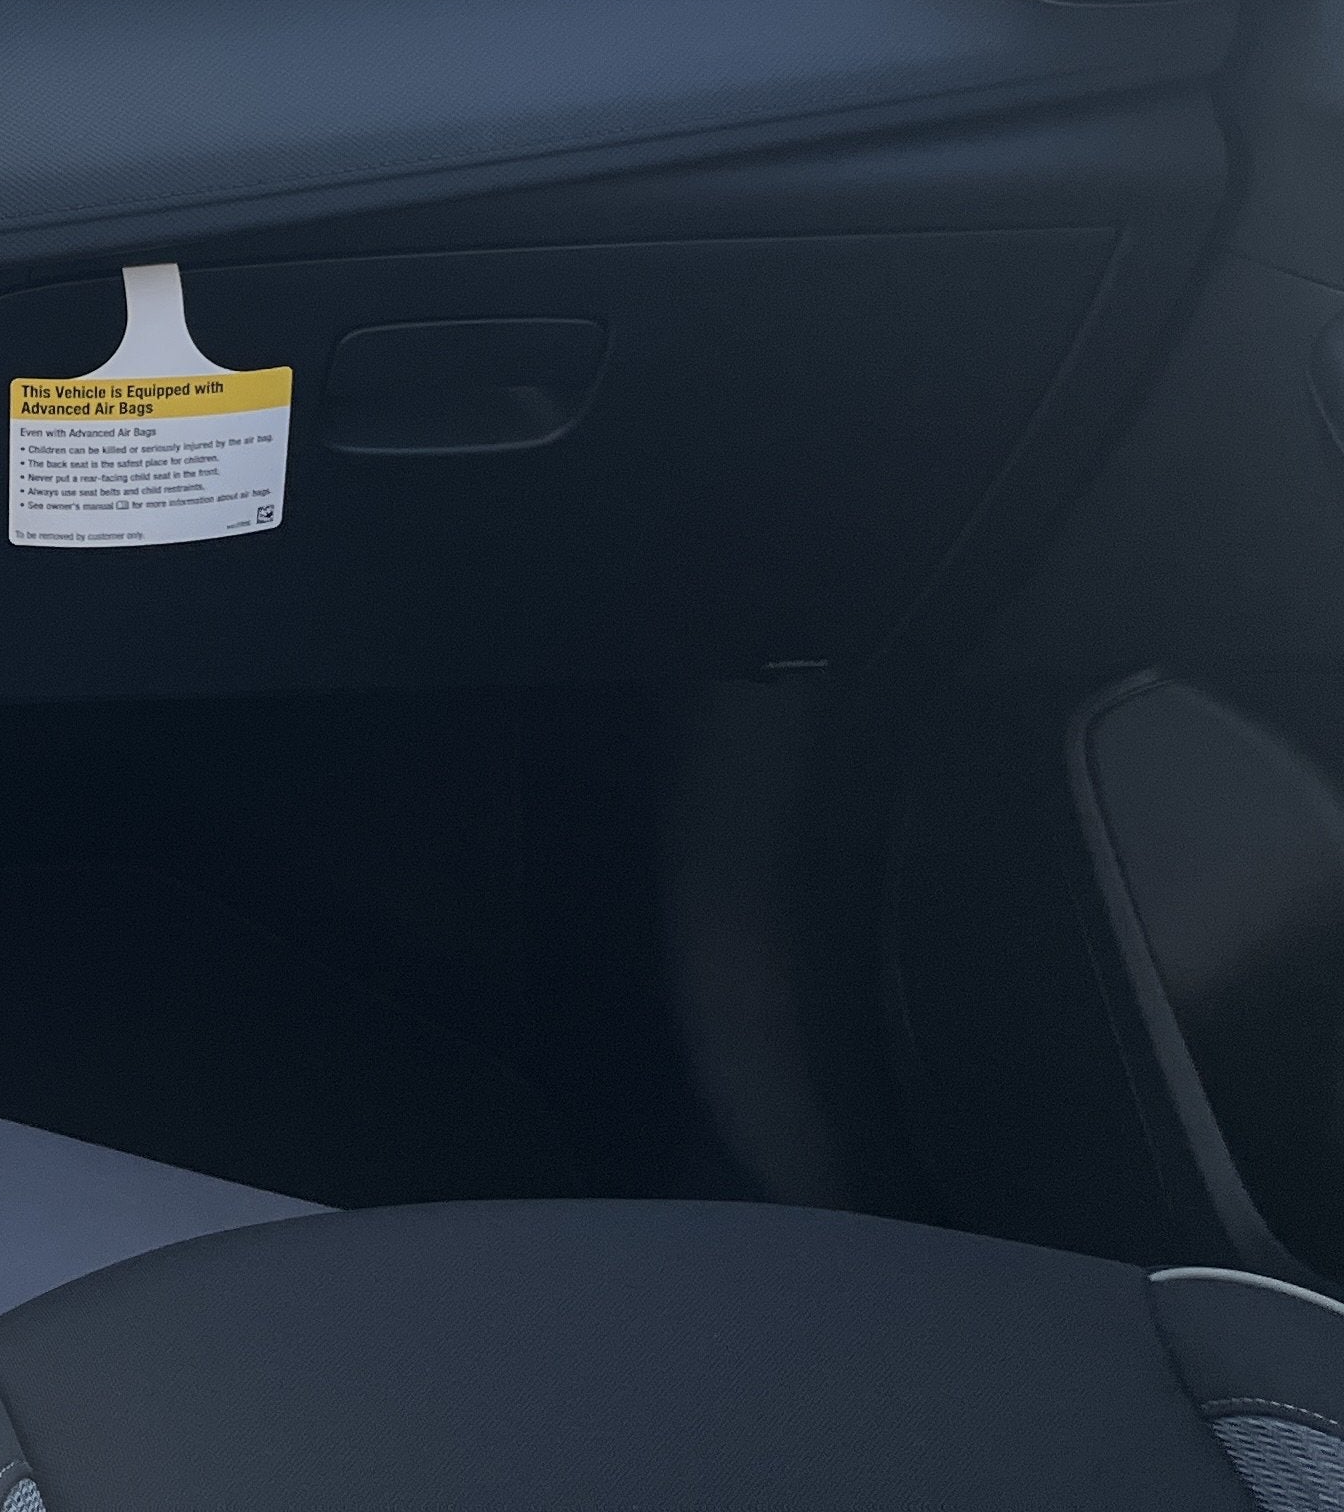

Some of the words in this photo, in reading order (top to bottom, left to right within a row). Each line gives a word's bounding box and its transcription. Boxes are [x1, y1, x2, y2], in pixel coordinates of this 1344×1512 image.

[21, 384, 51, 399] This
[55, 385, 107, 399] Vehicle
[111, 385, 123, 399] is
[127, 382, 191, 400] Equipped
[194, 380, 224, 395] with
[21, 401, 91, 416] Advanced
[95, 402, 116, 416] Air
[119, 400, 154, 417] Bags
[20, 427, 44, 438] Even
[45, 428, 67, 438] with
[68, 428, 116, 439] Advanced
[117, 428, 132, 438] Air
[133, 427, 157, 439] Bags
[28, 445, 67, 455] Children
[68, 447, 86, 455] can
[88, 446, 100, 455] be
[102, 445, 127, 454] killed
[129, 446, 139, 454] or
[141, 444, 180, 453] seriously
[184, 440, 214, 451] injured
[215, 439, 225, 448] by
[228, 438, 242, 446] the
[243, 436, 255, 445] air
[28, 459, 44, 468] The
[46, 460, 68, 468] back
[70, 460, 89, 468] seat
[90, 460, 99, 468] is
[101, 460, 115, 468] the
[117, 459, 143, 468] safest
[145, 458, 168, 469] place
[170, 457, 182, 465] for
[28, 473, 53, 482] Never
[55, 474, 70, 484] put
[80, 473, 129, 484] rear-facing
[130, 472, 152, 481] child
[153, 471, 171, 480] seat
[173, 471, 181, 479] in
[183, 470, 197, 479] the
[28, 487, 59, 498] Always
[61, 489, 76, 497] use
[79, 489, 98, 497] seat
[100, 487, 121, 497] belts
[123, 487, 140, 496] and
[141, 486, 162, 495] child
[28, 500, 44, 509] See
[132, 500, 143, 509] for
[145, 500, 167, 508] more
[169, 496, 215, 507] information
